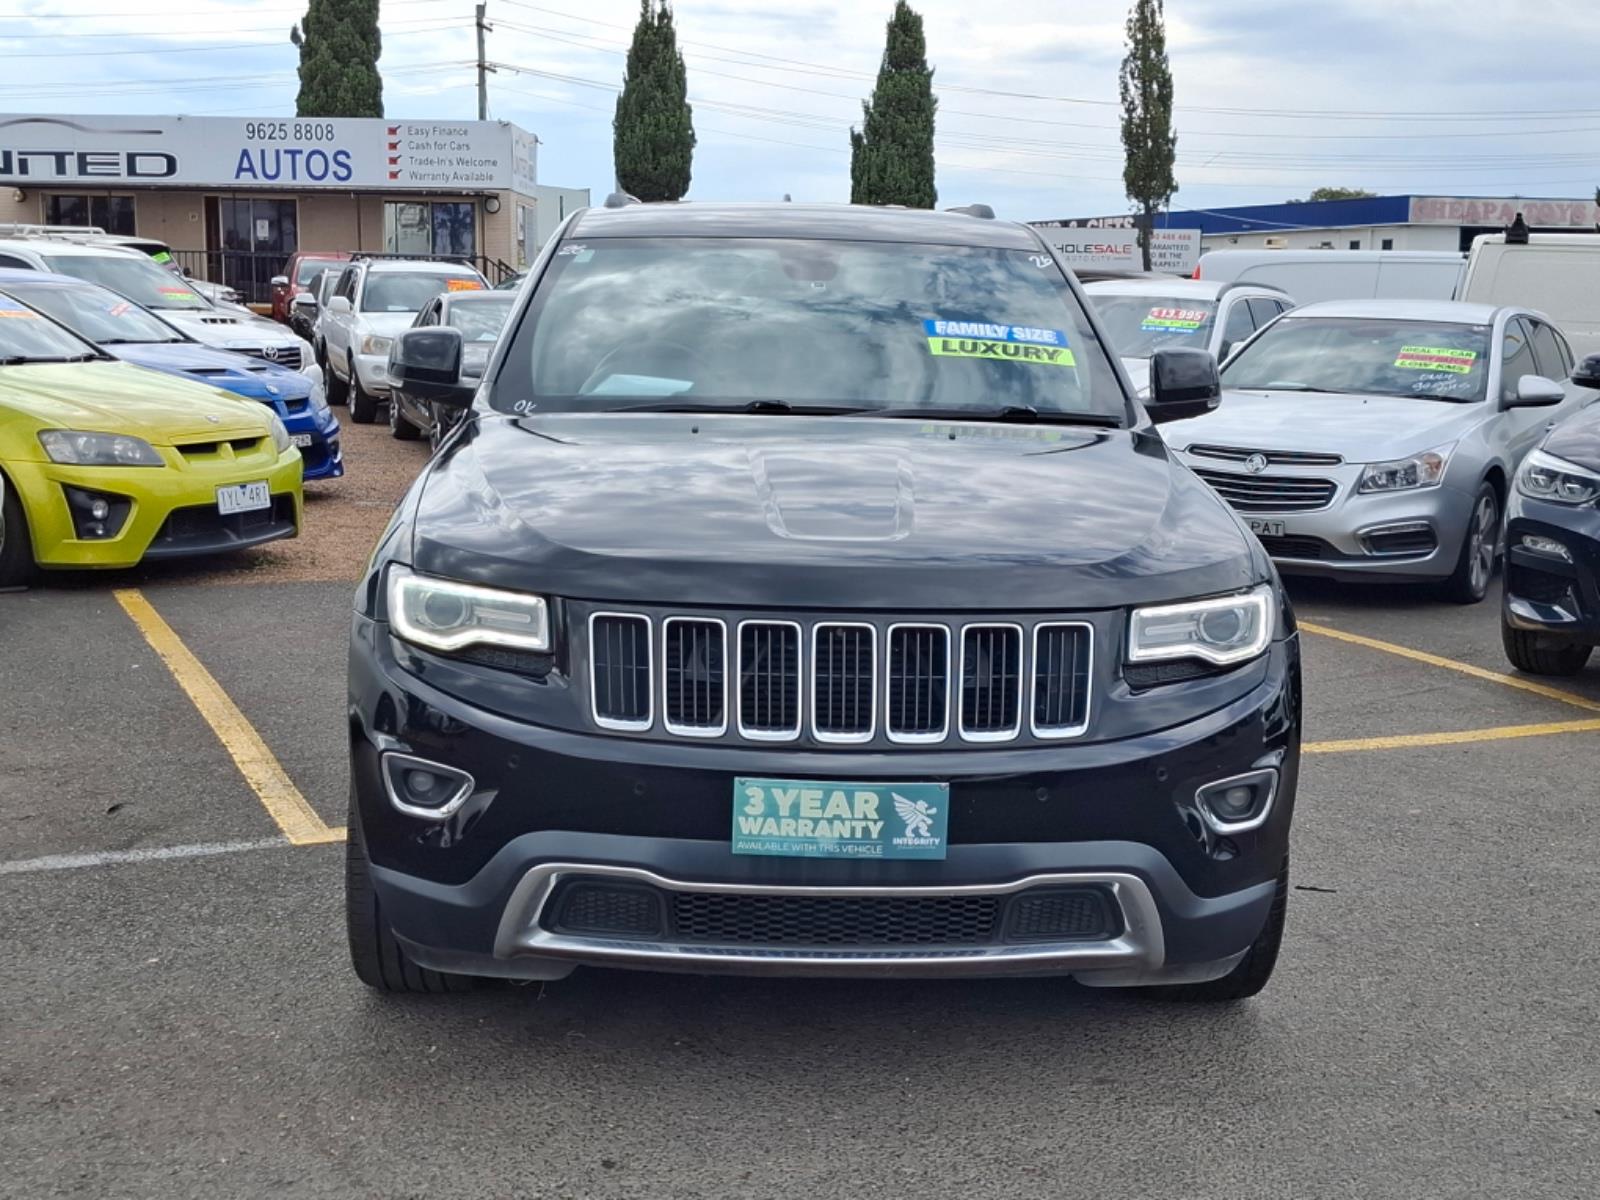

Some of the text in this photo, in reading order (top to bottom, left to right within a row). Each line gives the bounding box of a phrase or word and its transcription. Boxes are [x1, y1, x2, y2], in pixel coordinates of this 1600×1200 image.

[246, 122, 335, 141] 9625 8808
[407, 126, 469, 138] Easy Finance
[408, 140, 471, 151] Cash for Cars
[235, 148, 352, 182] AUTOS
[409, 156, 498, 168] Trade-In's Welcome
[409, 171, 494, 183] Warranty Available
[1413, 198, 1514, 221] CHEAPA
[1524, 201, 1587, 222] TOYS
[1053, 243, 1132, 254] HOLESALE
[1151, 243, 1190, 251] ARANTEED
[1151, 260, 1181, 268] EAPEST
[934, 321, 1058, 343] FAMILY SIZE
[942, 340, 1063, 362] LUXURY
[744, 786, 880, 819] 3 YEAR
[737, 816, 885, 839] WARRANTY
[736, 840, 883, 854] AVAILABLE WITH THIS VEHICLE
[892, 837, 940, 846] INTEGRITY
